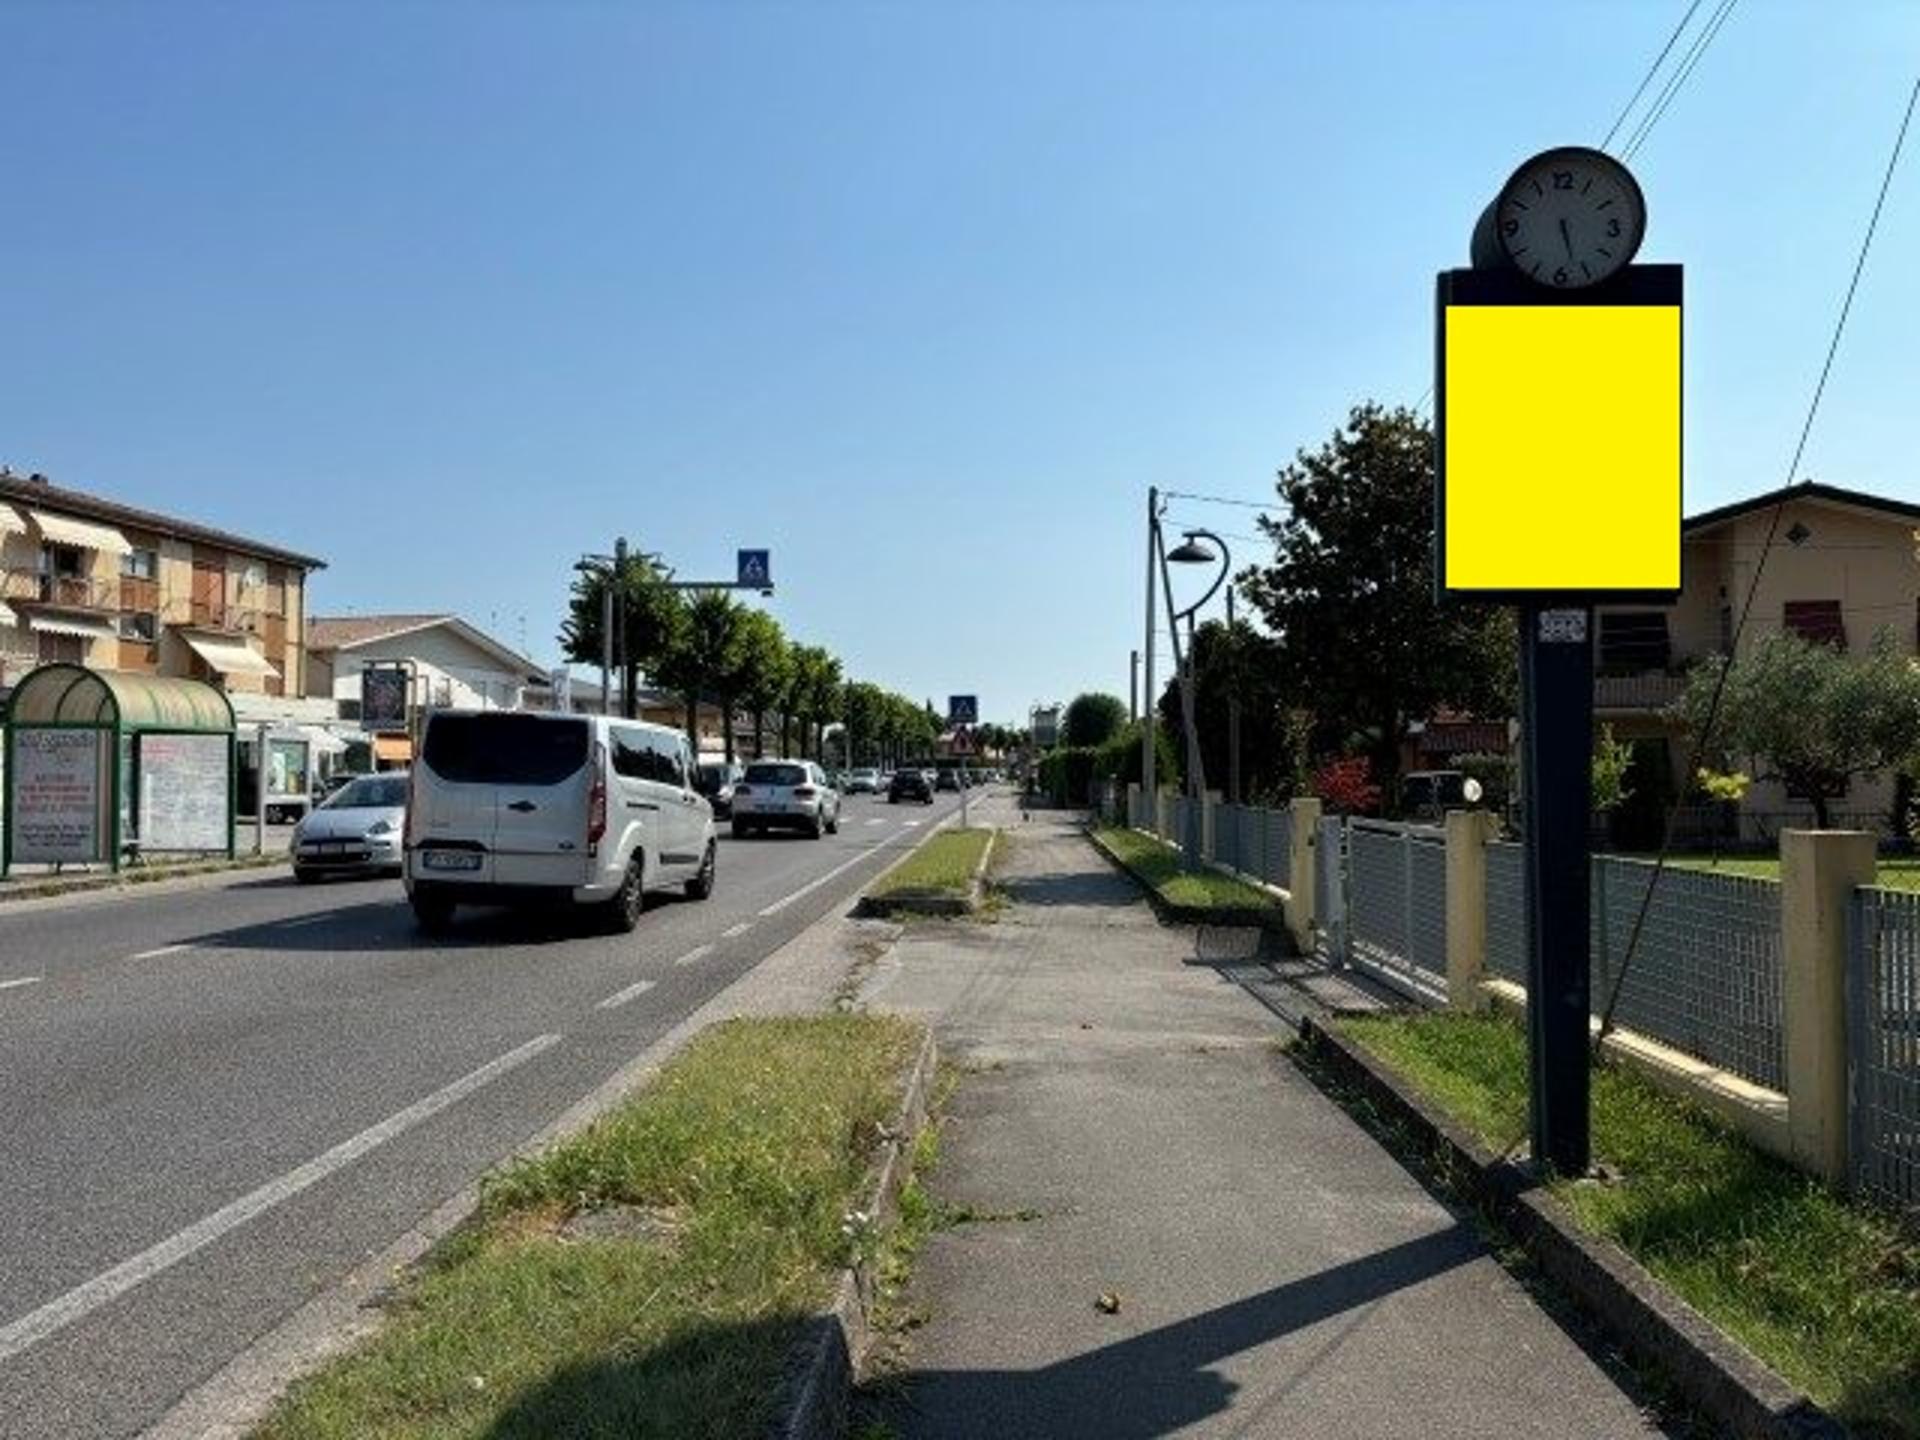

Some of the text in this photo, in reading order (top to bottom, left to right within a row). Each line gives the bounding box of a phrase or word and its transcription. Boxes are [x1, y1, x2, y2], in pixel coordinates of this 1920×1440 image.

[1553, 171, 1574, 189] 12
[1505, 219, 1519, 237] 9
[1608, 219, 1621, 237] 3
[1553, 267, 1568, 284] 6
